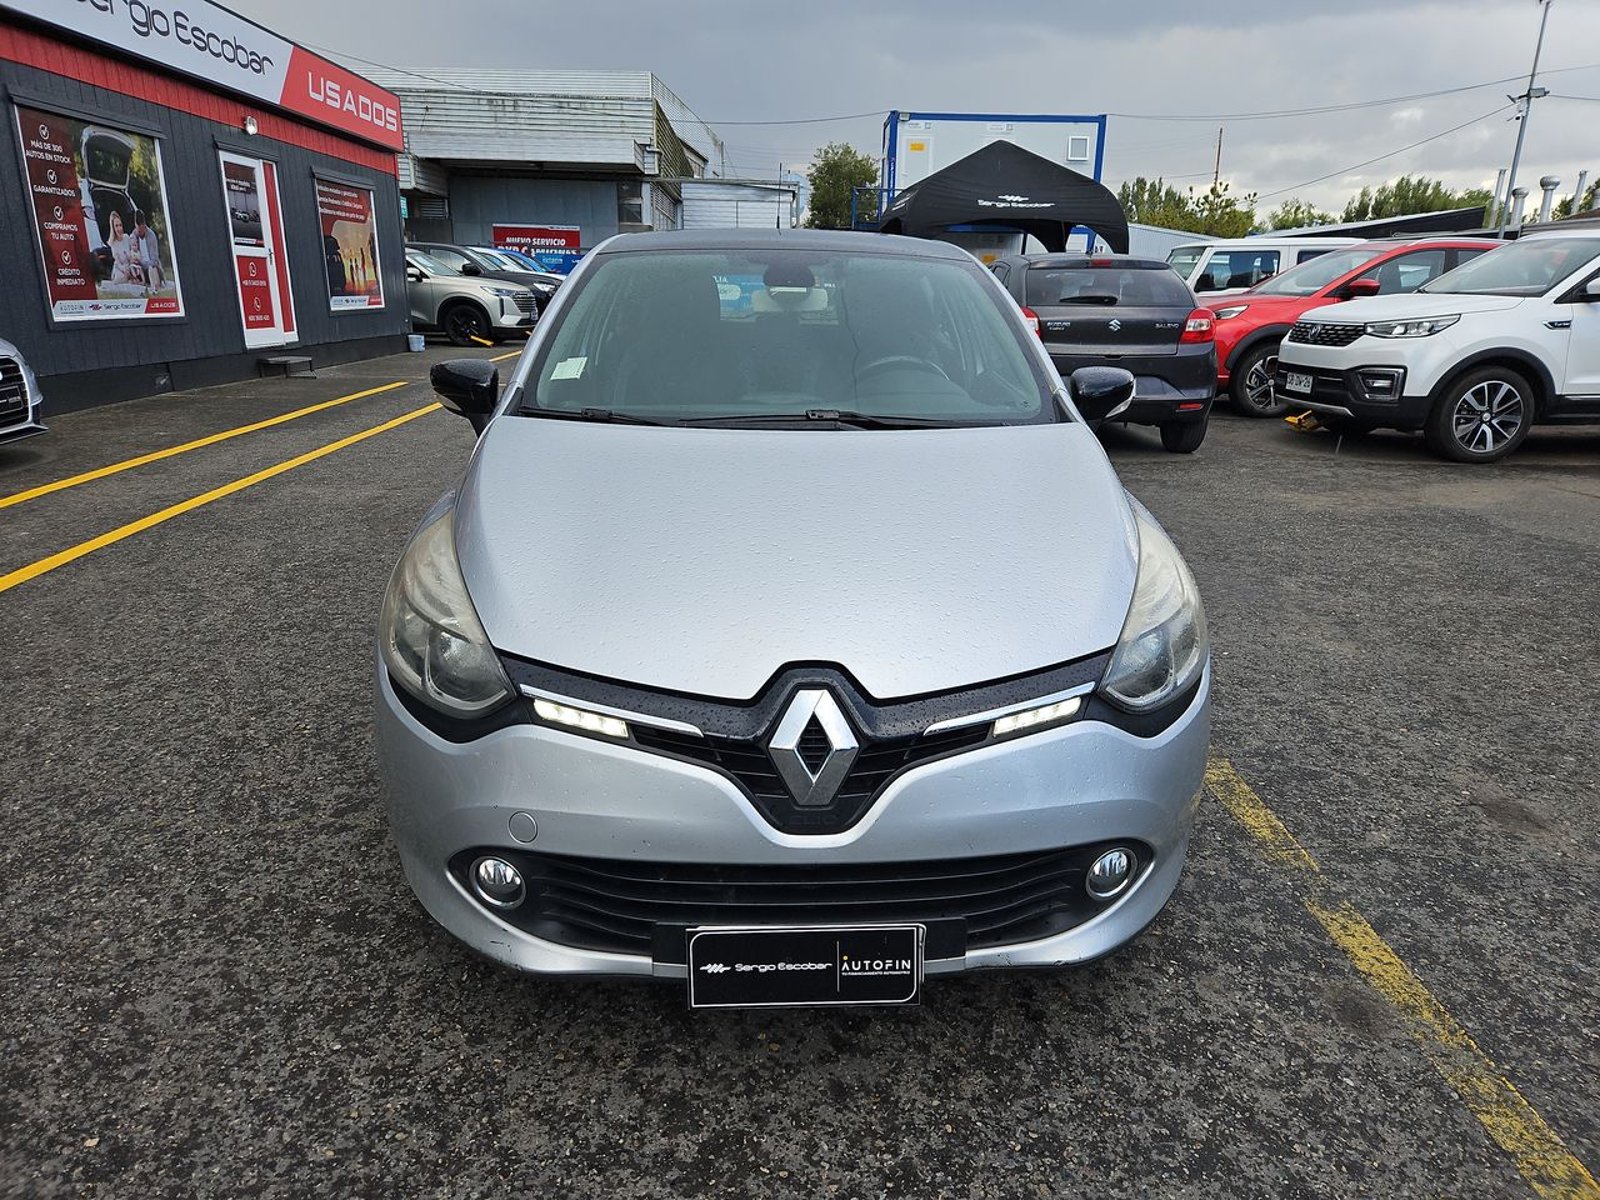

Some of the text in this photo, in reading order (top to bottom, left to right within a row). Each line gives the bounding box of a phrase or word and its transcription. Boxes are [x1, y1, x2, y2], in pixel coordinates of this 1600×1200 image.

[173, 11, 275, 75] Escobar
[308, 71, 397, 132] USADOS
[43, 143, 51, 151] DE
[26, 150, 71, 164] AUTOS EN STOCK
[33, 185, 76, 197] GARANTIZADOS
[44, 222, 78, 231] COMPRAMOS
[51, 232, 75, 241] TU AUTO
[532, 237, 566, 246] SERVICIO
[57, 278, 86, 286] INMEDIATO
[734, 956, 911, 973] Sergio Escobar AUTOFIN
